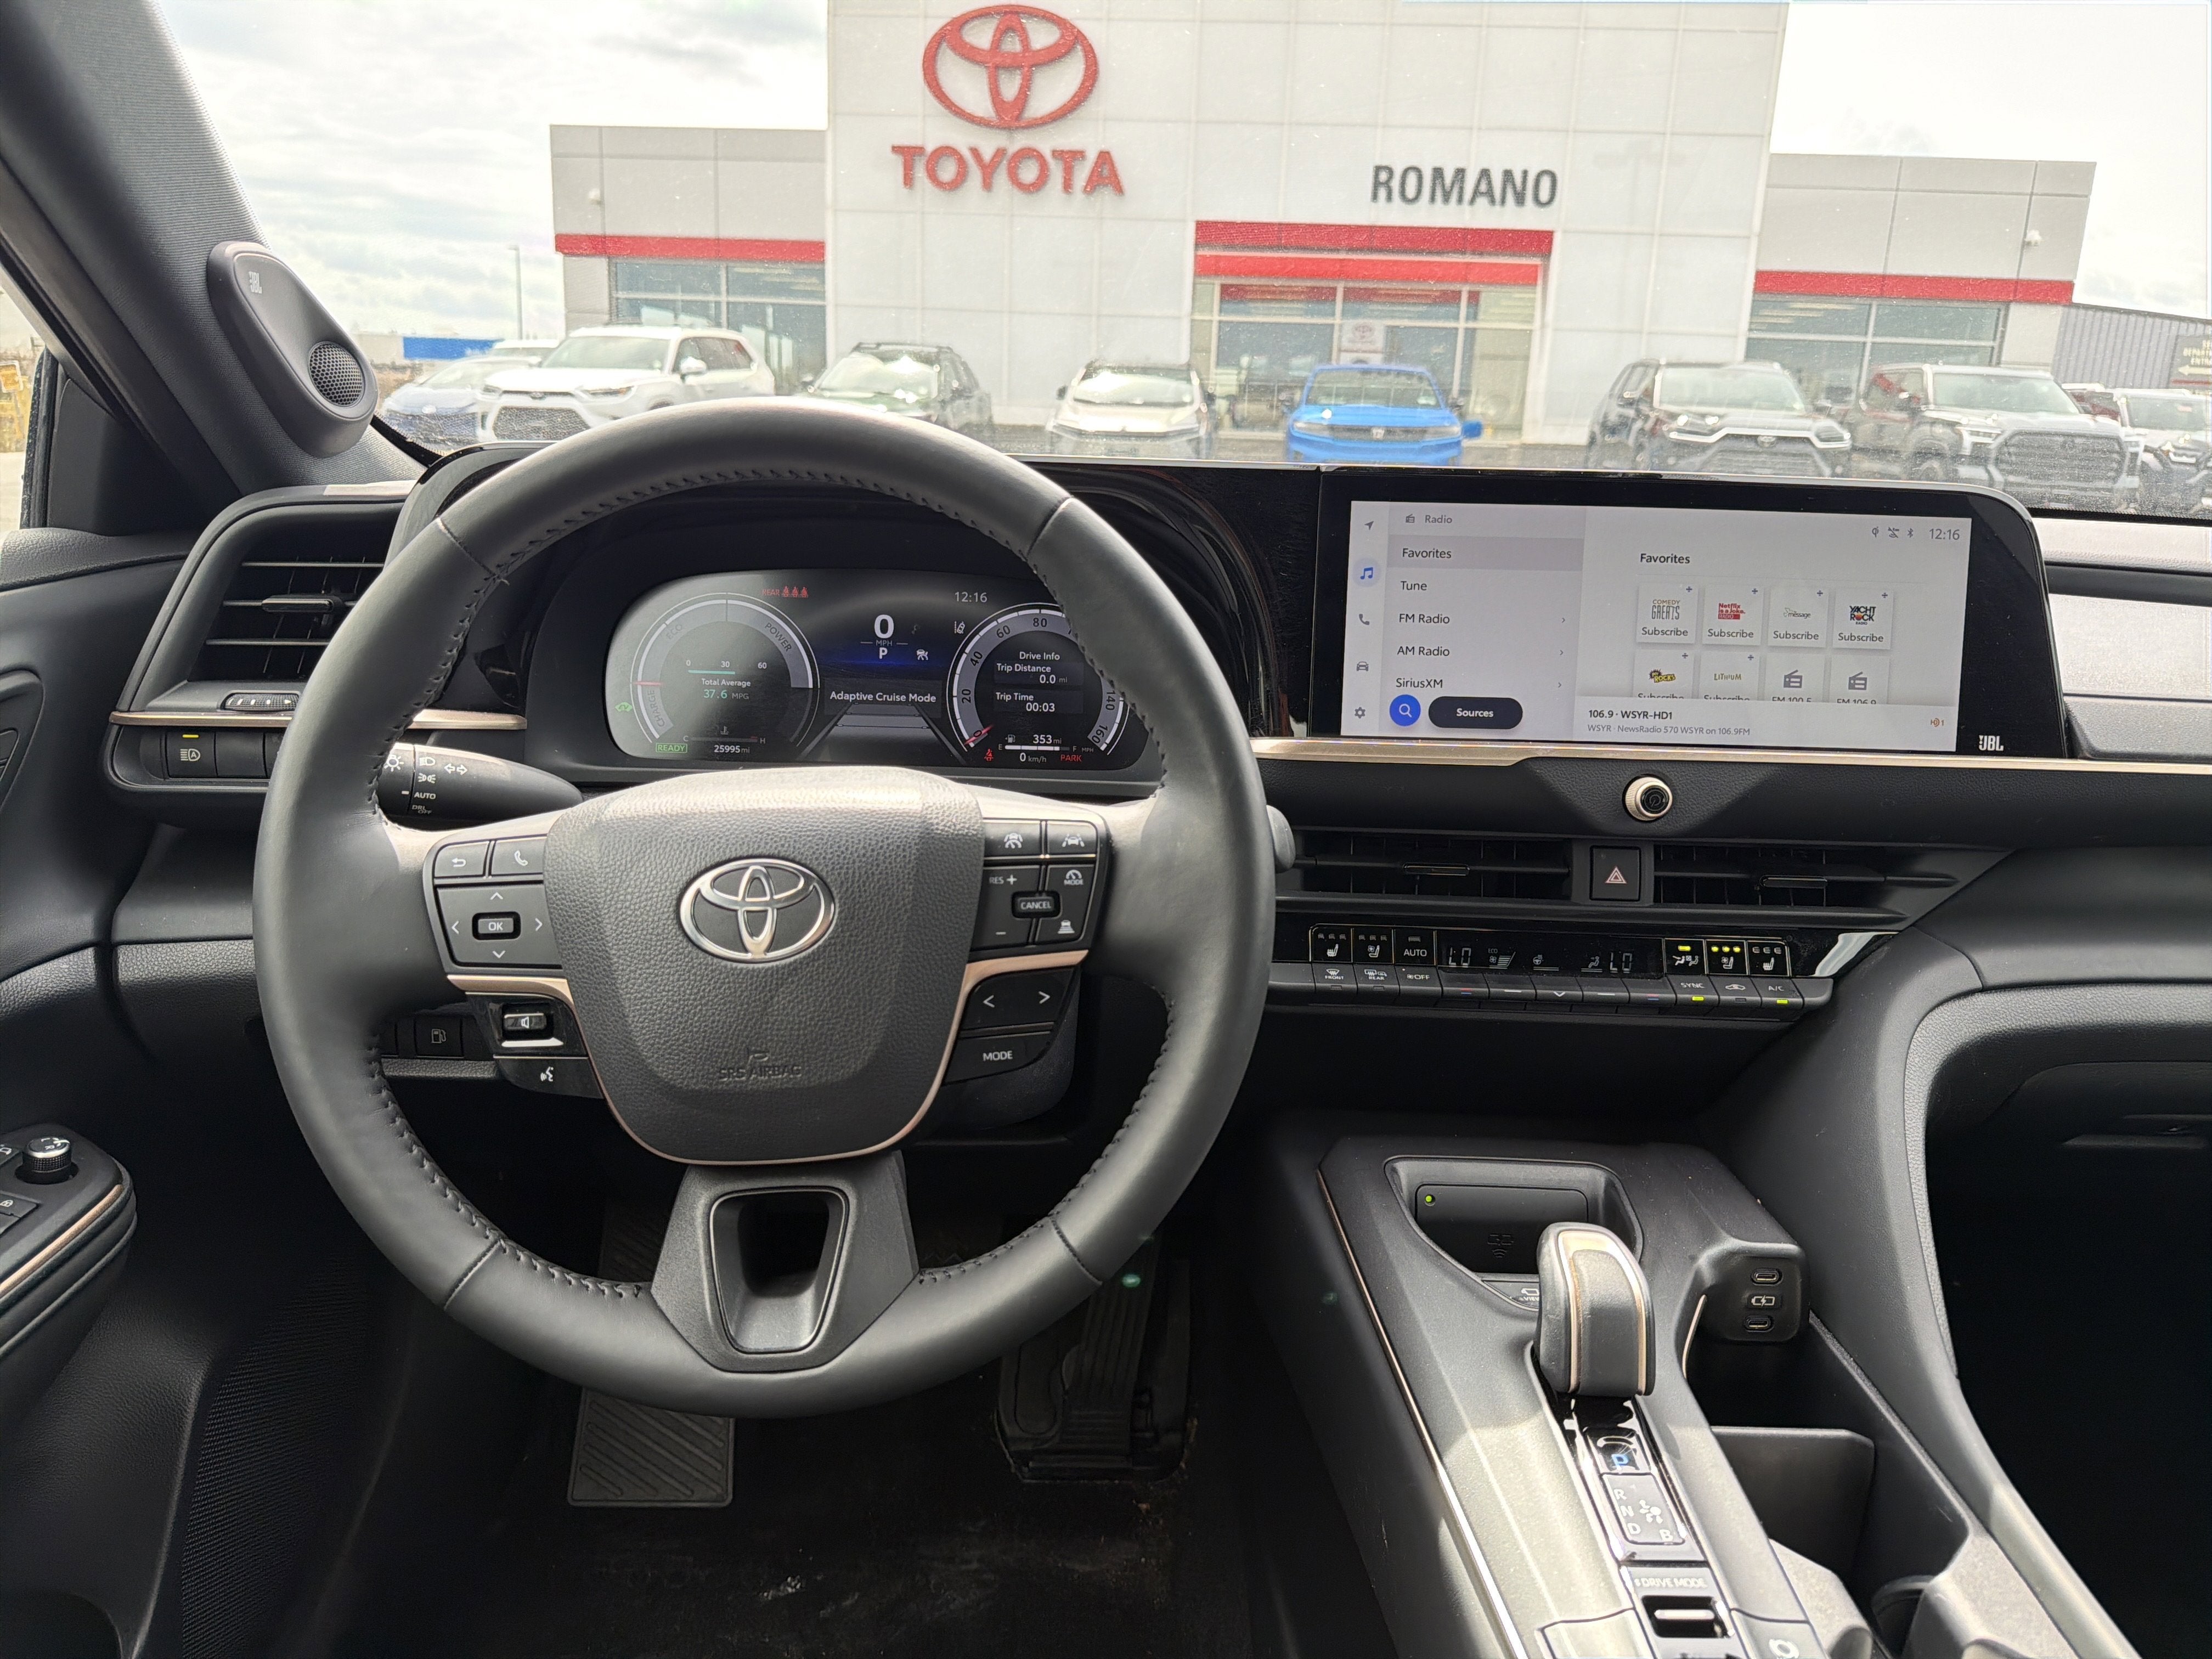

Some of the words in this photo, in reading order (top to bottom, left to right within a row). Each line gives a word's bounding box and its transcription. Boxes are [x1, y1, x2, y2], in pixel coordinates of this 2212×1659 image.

[891, 145, 1124, 196] TOYOTA
[1372, 165, 1558, 208] ROMANO
[1424, 514, 1452, 524] Radio
[1929, 528, 1960, 540] 12:16
[1402, 548, 1452, 559] Favorites
[1640, 553, 1690, 565] Favorites
[1401, 580, 1427, 591] Tune
[955, 591, 988, 603] 12:16
[1651, 605, 1680, 620] GREATS
[1849, 606, 1876, 614] YACHT
[1032, 618, 1047, 628] 80
[1398, 613, 1415, 624] FM
[1418, 613, 1450, 624] Radio
[1850, 613, 1875, 622] ROCK
[665, 624, 683, 640] ECO
[874, 614, 894, 639] 0
[996, 625, 1011, 638] 60
[1641, 627, 1688, 636] Subscribe
[765, 623, 792, 652] POWER
[1707, 629, 1754, 638] Subscribe
[1773, 631, 1819, 640] Subscribe
[1838, 633, 1884, 642] Subscribe
[879, 647, 888, 659] P
[1019, 652, 1041, 660] Drive
[1043, 652, 1060, 660] Info
[1397, 646, 1415, 656] AM
[1418, 646, 1450, 657] Radio
[970, 651, 983, 667] 40
[996, 663, 1013, 673] Trip
[1015, 664, 1051, 673] Distance
[721, 679, 751, 687] Average
[1040, 675, 1056, 684] 0.0
[1396, 678, 1443, 689] SiriusXM
[1654, 674, 1675, 682] ROCKS
[704, 689, 727, 699] 37.6
[830, 691, 873, 701] Adaptive
[876, 692, 906, 702] Cruise
[909, 693, 936, 702] Mode
[962, 689, 971, 703] 20
[996, 692, 1012, 702] Trip
[1014, 693, 1034, 701] Time
[1105, 690, 1116, 711] 140
[647, 690, 665, 727] CHARGE
[1026, 703, 1055, 712] 00:03
[1456, 707, 1494, 718] Sources
[1589, 710, 1613, 719] 106.9
[1621, 710, 1672, 719] WSYR-HD1
[1091, 725, 1108, 744] 160
[1718, 727, 1750, 736] 106.9FM
[1979, 735, 2004, 751] JBL
[1020, 753, 1026, 761] 0
[1021, 901, 1052, 910] CANCEL
[488, 922, 503, 932] OK
[983, 1051, 1013, 1061] MODE
[748, 1065, 802, 1080] AIRBAG
[1614, 1488, 1626, 1500] R
[1620, 1505, 1634, 1517] N
[1628, 1523, 1641, 1534] D
[1659, 1530, 1673, 1542] B
[1640, 1578, 1673, 1588] DRIVE
[1674, 1578, 1708, 1588] MODE
